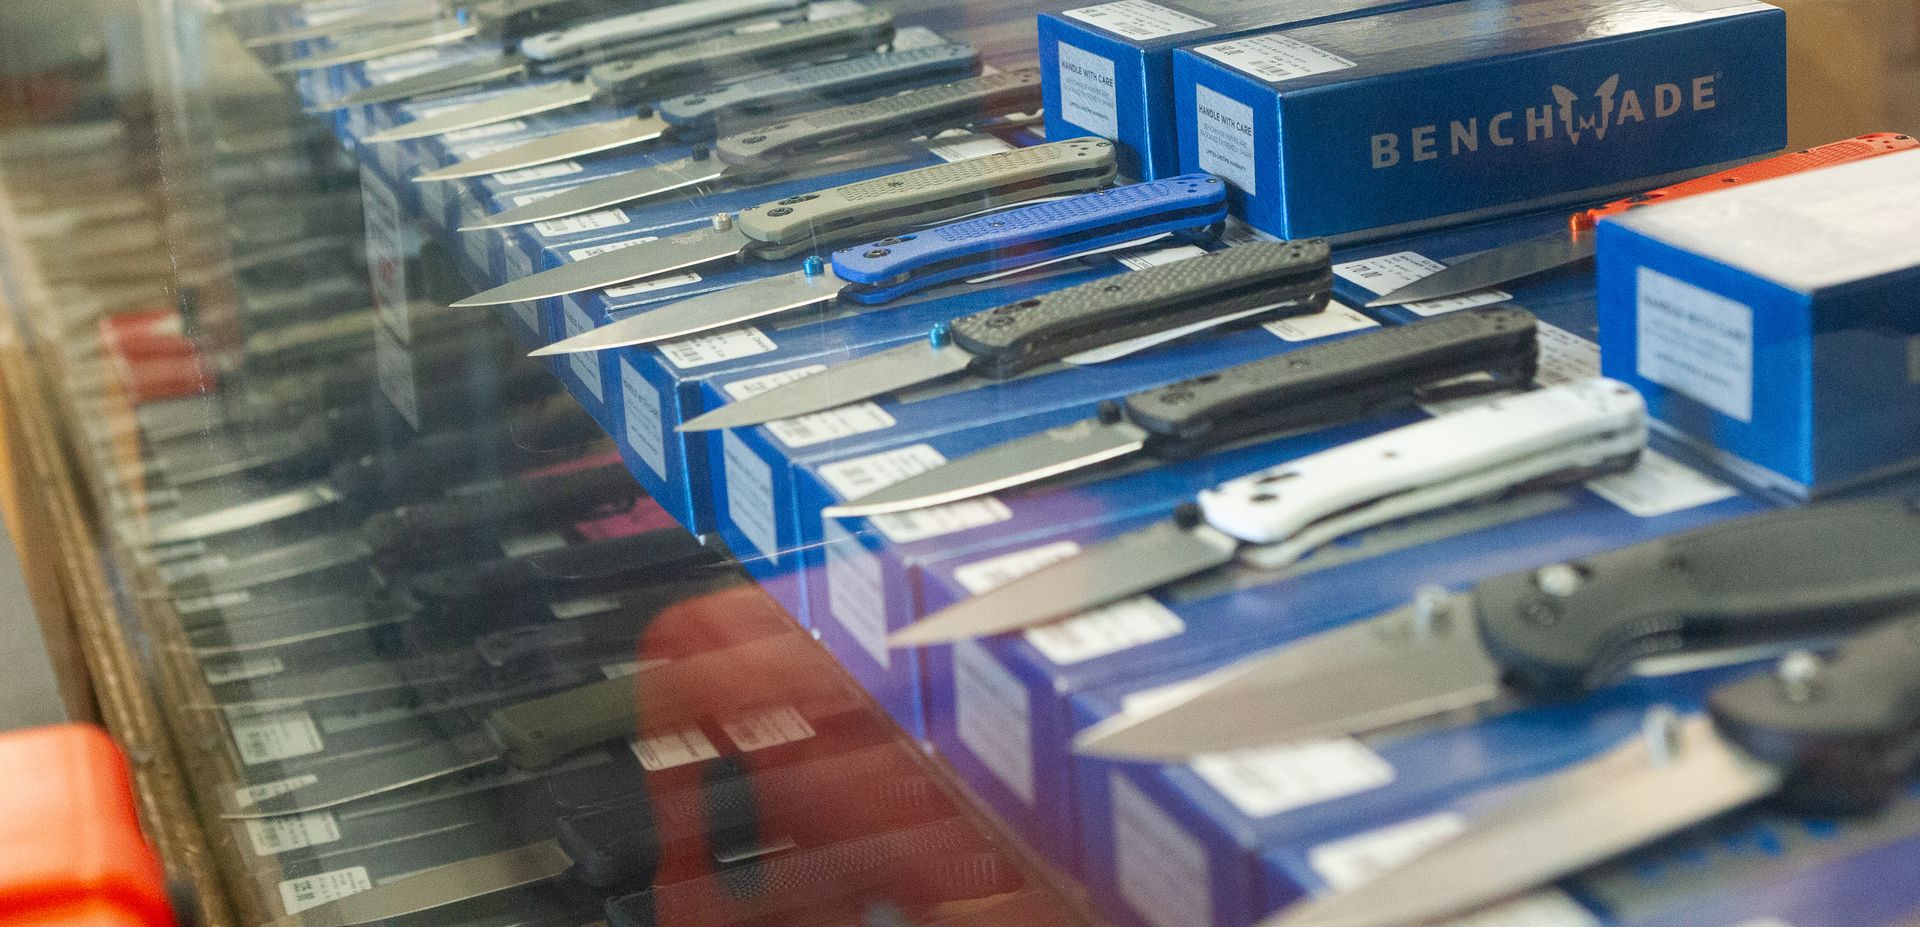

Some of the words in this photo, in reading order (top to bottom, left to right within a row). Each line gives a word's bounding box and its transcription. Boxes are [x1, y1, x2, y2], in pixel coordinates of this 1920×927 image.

[1061, 61, 1082, 76] HANDLE
[1082, 68, 1098, 82] WITH
[1098, 74, 1114, 88] CARE
[1198, 104, 1220, 122] HANDLE
[1220, 114, 1236, 129] WITH
[1236, 121, 1252, 137] CARE
[1370, 73, 1716, 169] BENCHMADE
